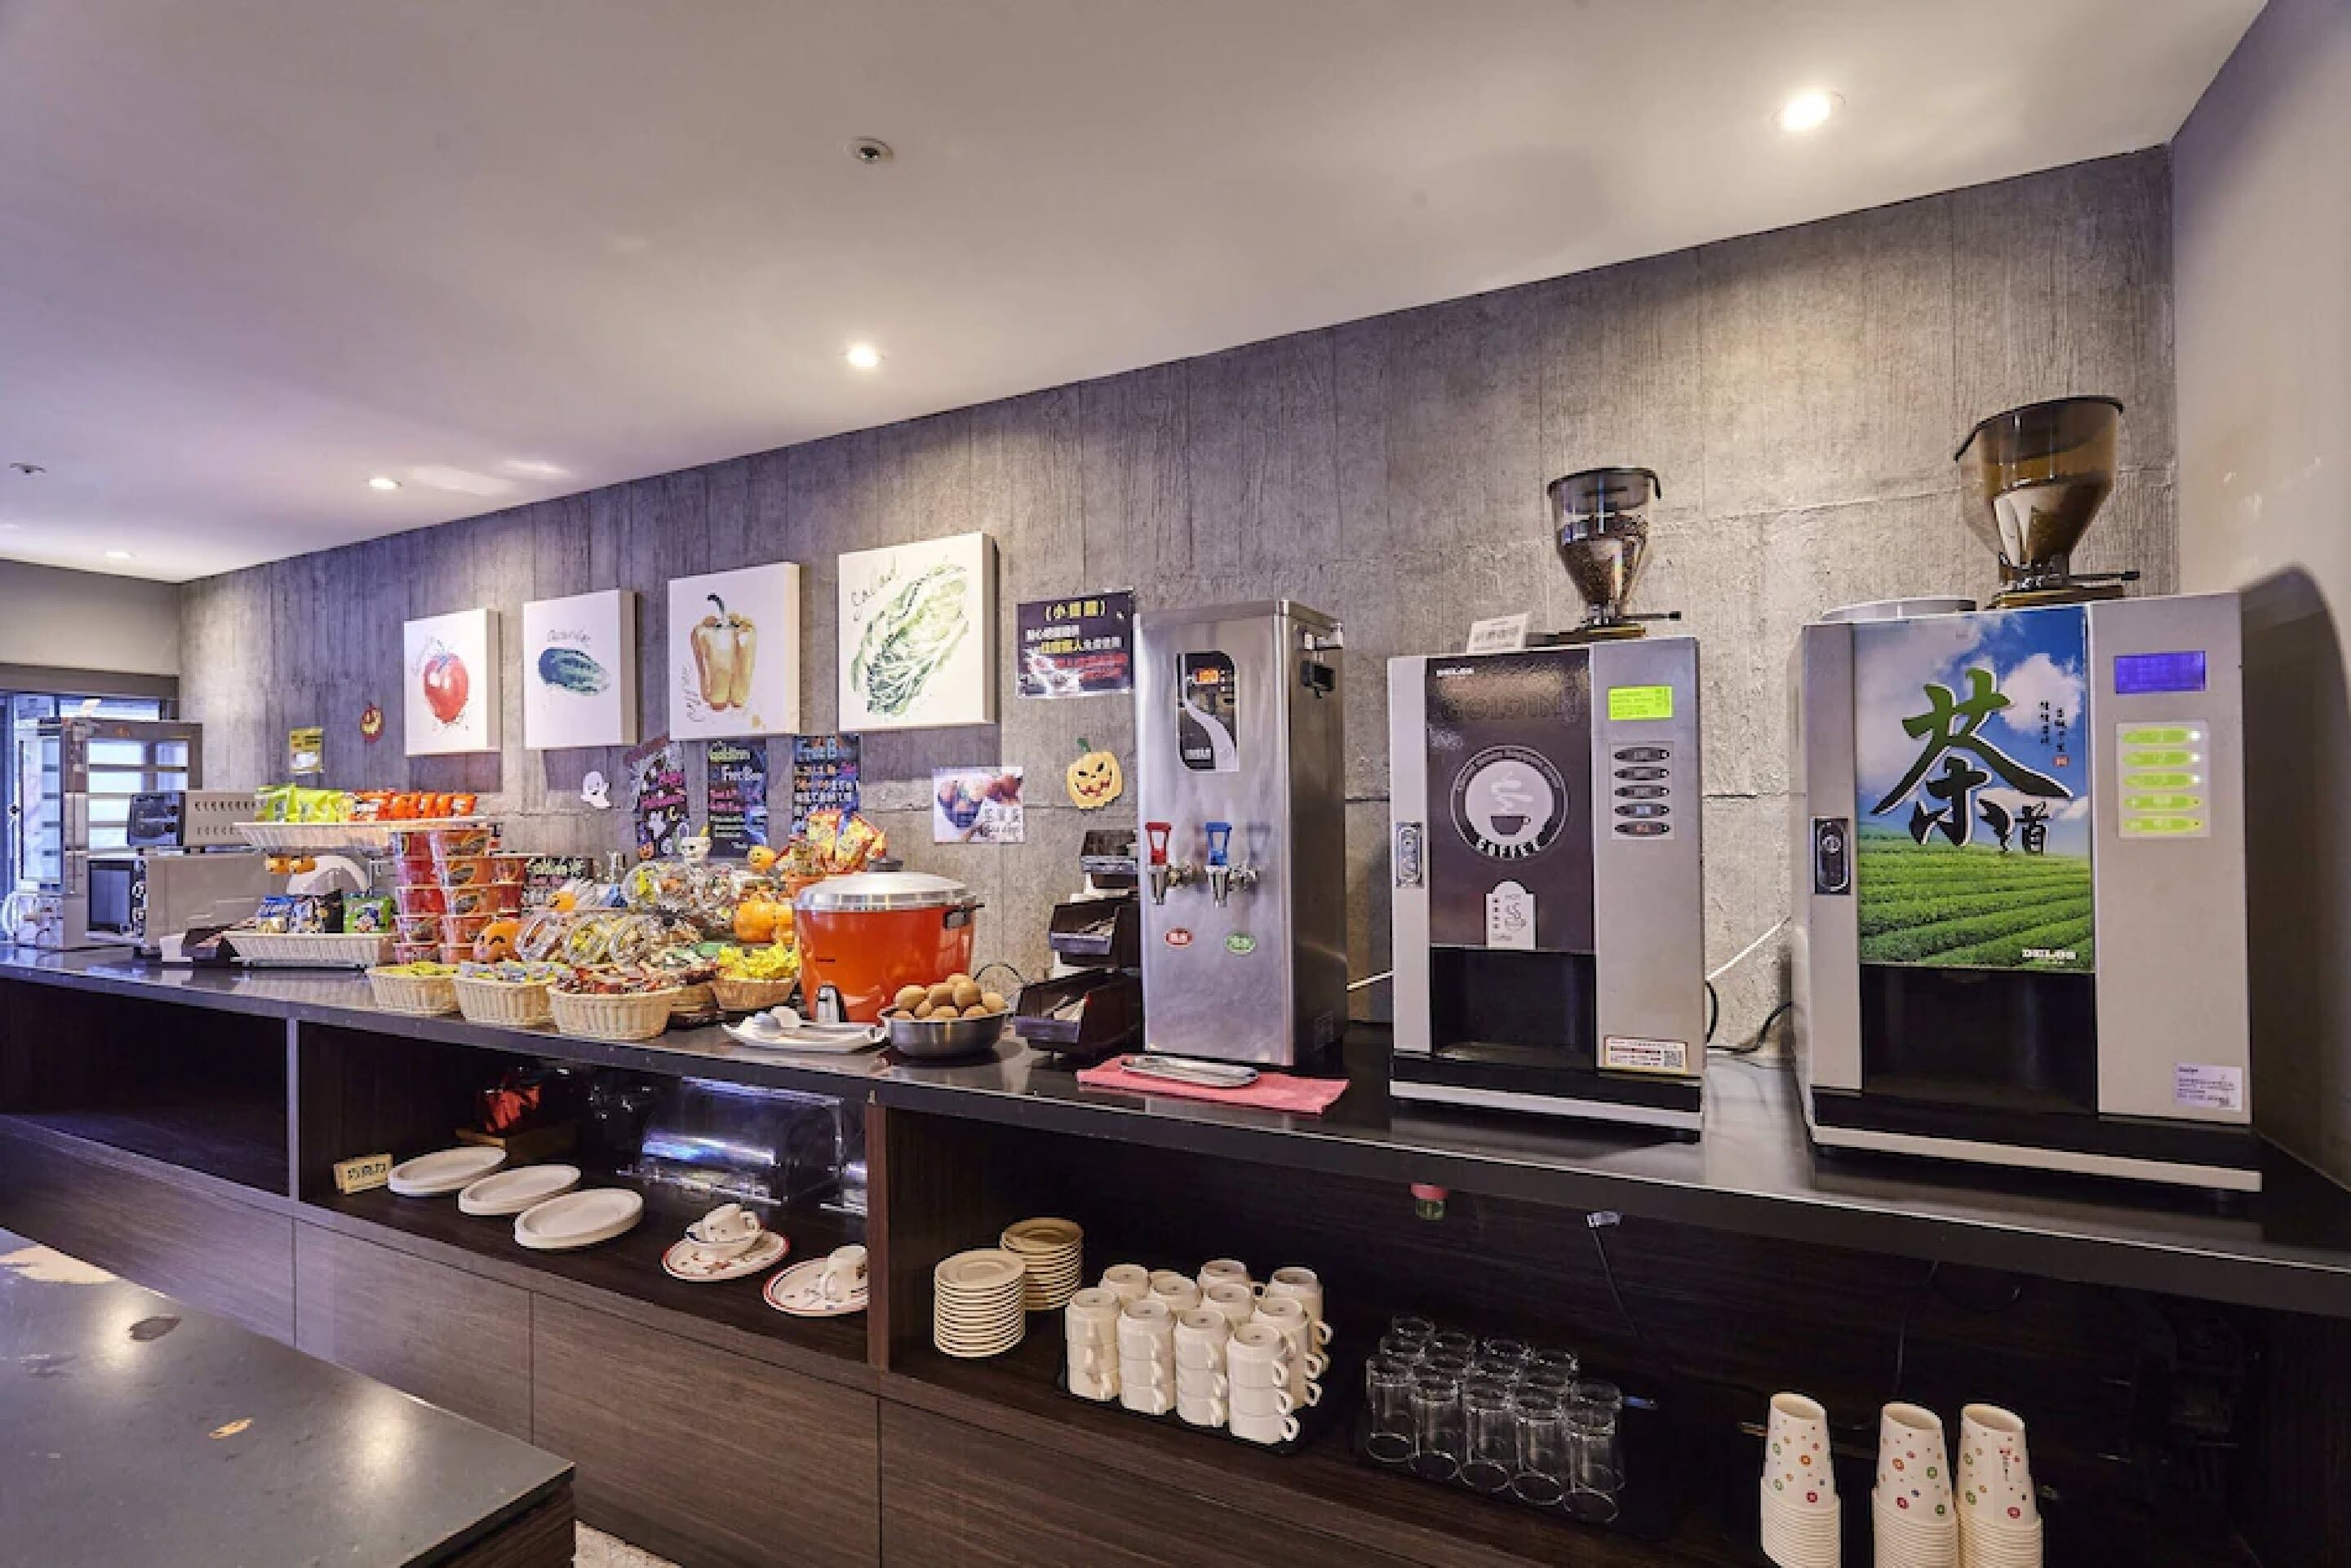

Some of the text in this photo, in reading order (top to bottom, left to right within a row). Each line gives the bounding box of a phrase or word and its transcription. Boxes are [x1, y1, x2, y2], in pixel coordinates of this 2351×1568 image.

[1870, 667, 2074, 856] 茶道
[1475, 837, 1541, 859] COFFEE
[2022, 947, 2077, 960] DELOS
